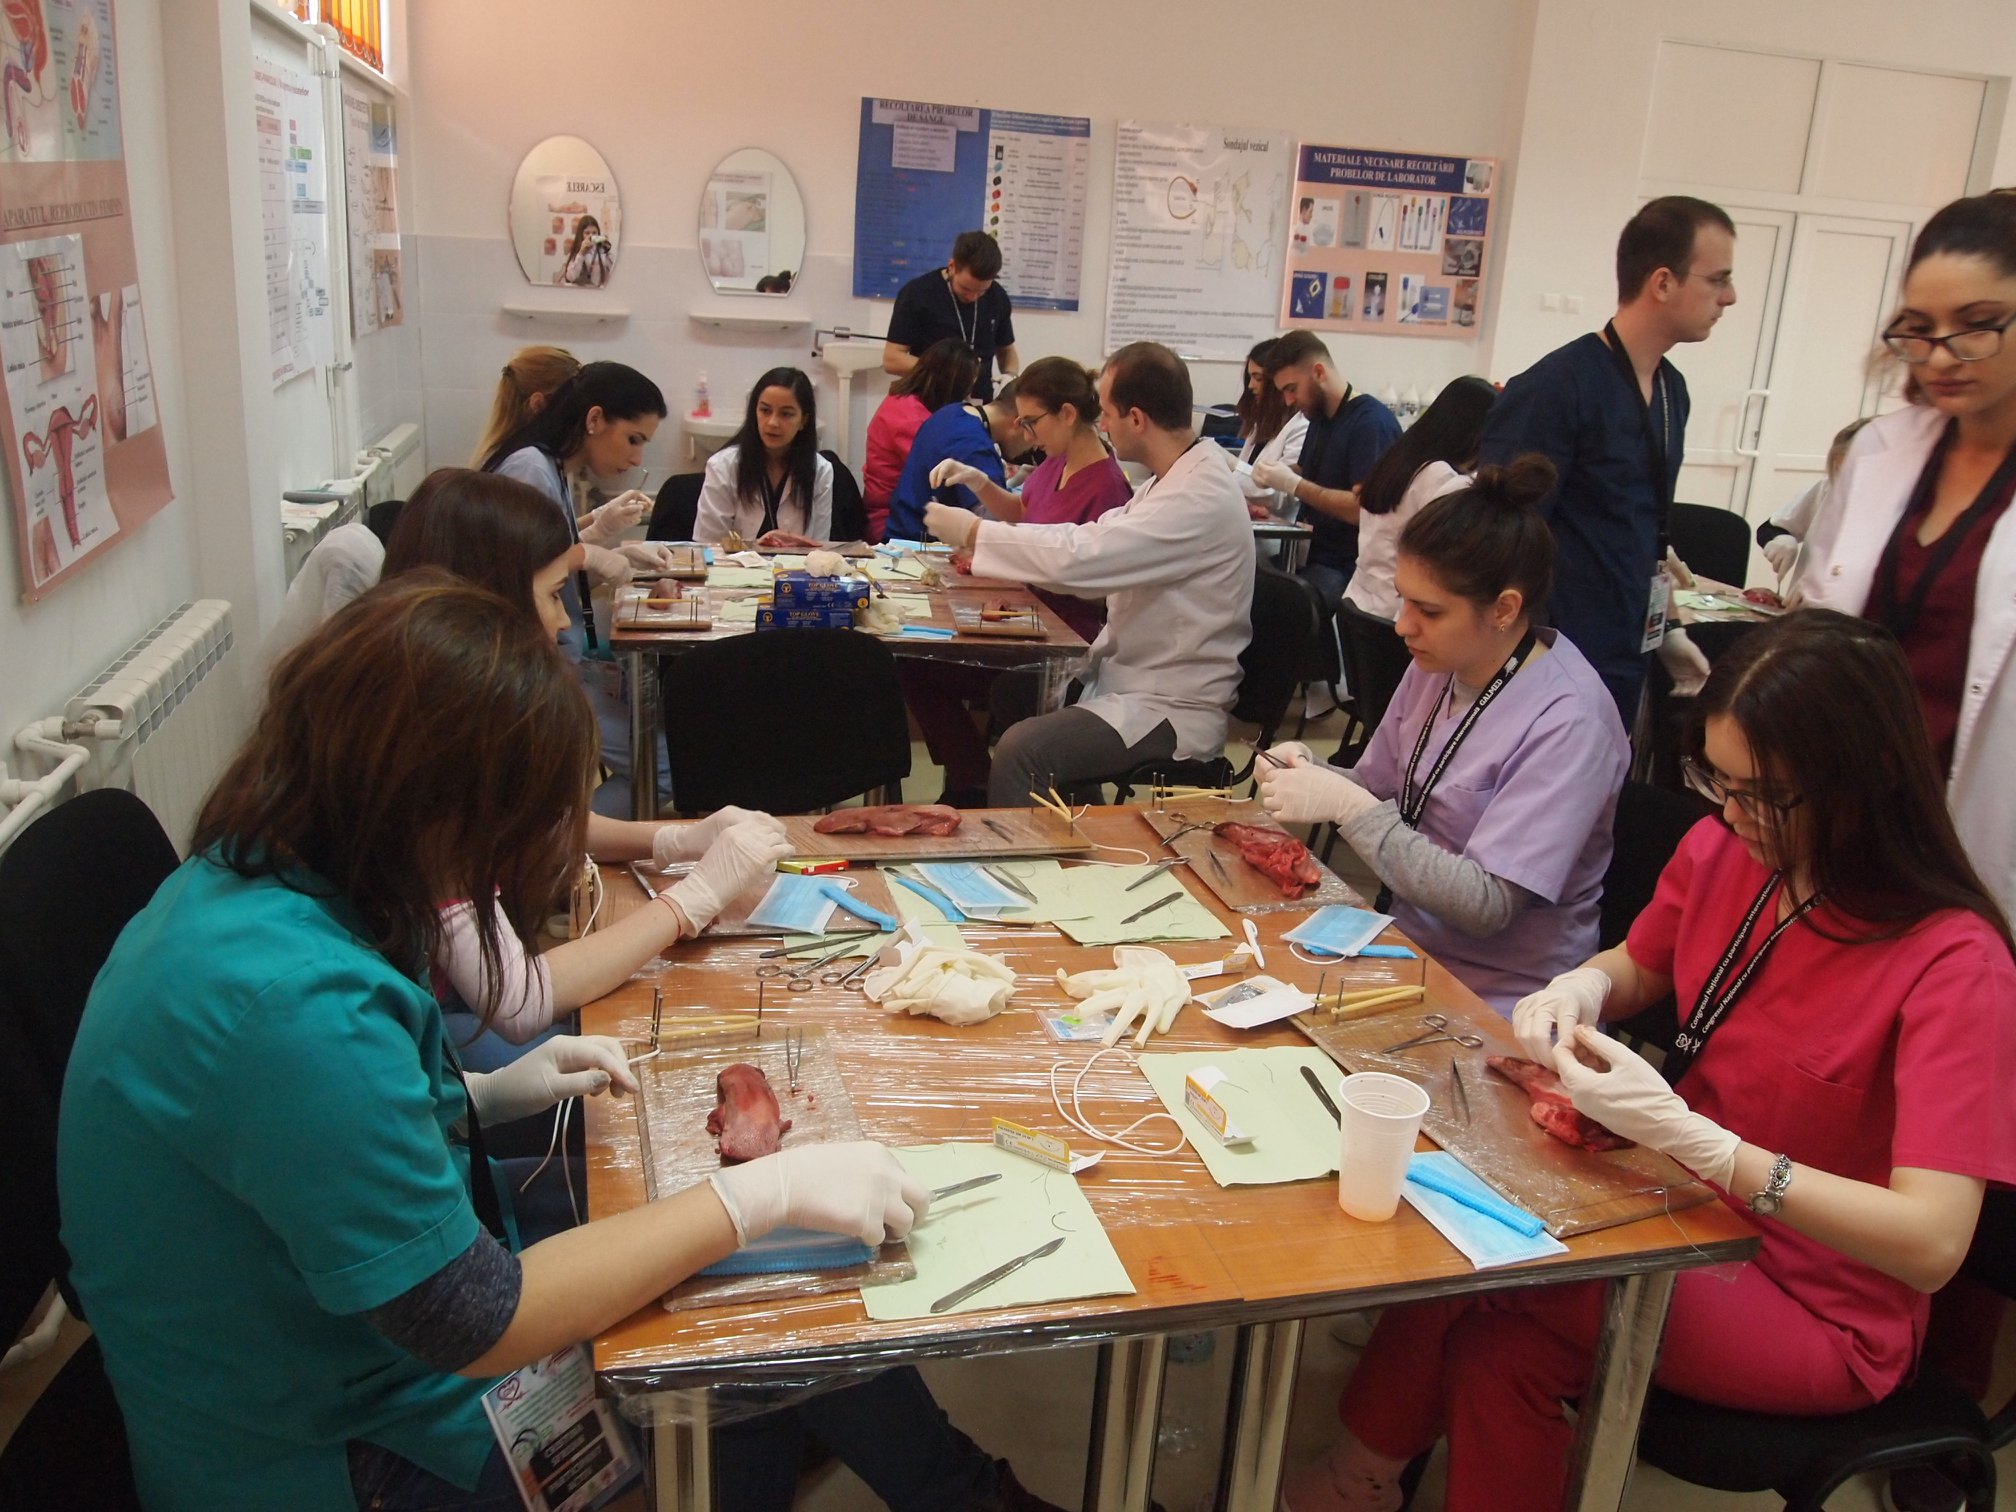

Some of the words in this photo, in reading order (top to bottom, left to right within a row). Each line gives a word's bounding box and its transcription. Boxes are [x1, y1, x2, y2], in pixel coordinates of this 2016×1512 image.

[1313, 152, 1362, 166] MATERIALE
[1363, 156, 1405, 170] NECESARE
[1330, 167, 1372, 180] PROBELOR
[1374, 169, 1385, 181] DE
[1387, 172, 1437, 185] LABORATOR
[1479, 678, 1503, 706] GALMED
[1690, 994, 1710, 1029] Congresul
[1722, 957, 1730, 967] cu
[1727, 921, 1750, 959] participare
[1702, 1003, 1724, 1034] Congresul
